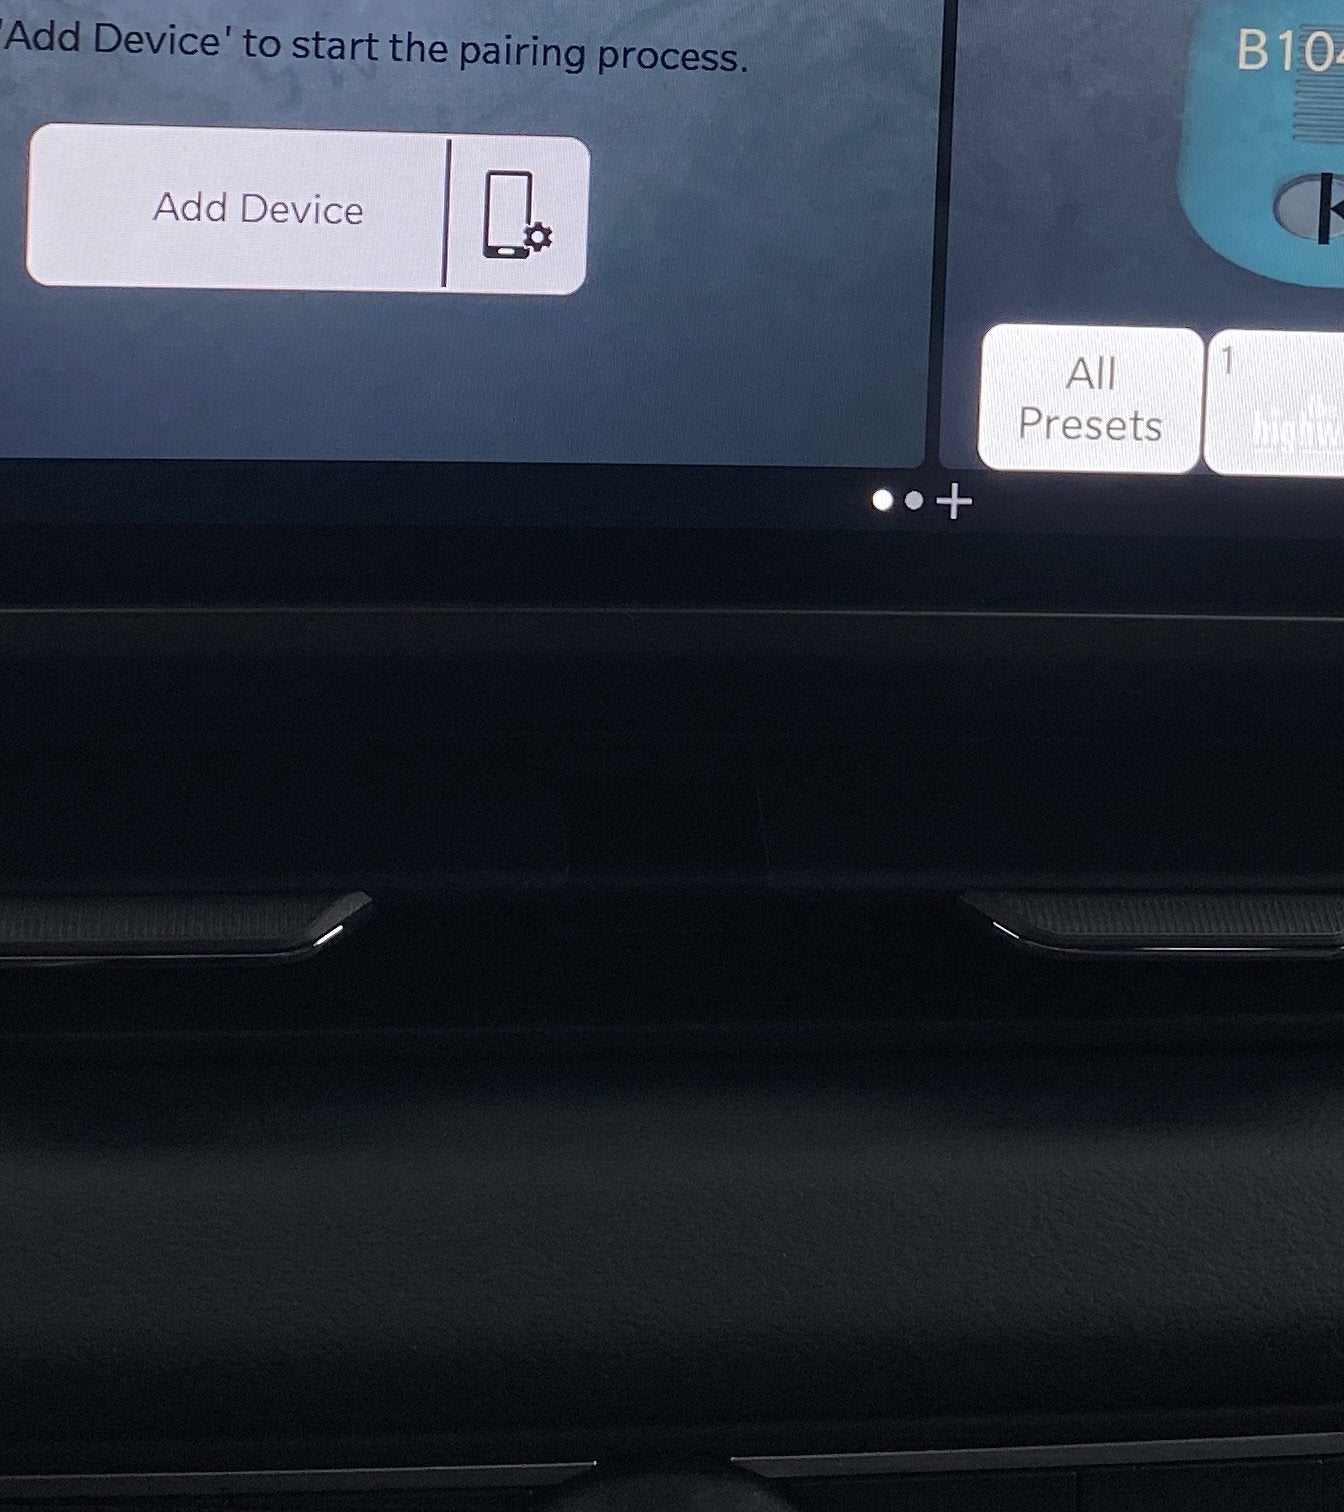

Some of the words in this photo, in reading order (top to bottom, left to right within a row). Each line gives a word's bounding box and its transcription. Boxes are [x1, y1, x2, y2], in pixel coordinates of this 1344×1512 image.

[94, 22, 233, 59] Device'
[242, 30, 282, 61] to
[290, 32, 382, 64] start
[389, 33, 450, 65] the
[459, 36, 587, 75] pairing
[597, 44, 749, 75] process.
[153, 190, 229, 225] Add
[241, 191, 365, 229] Device
[1065, 355, 1117, 391] All
[1222, 345, 1233, 375] 1
[1018, 404, 1163, 443] Presets
